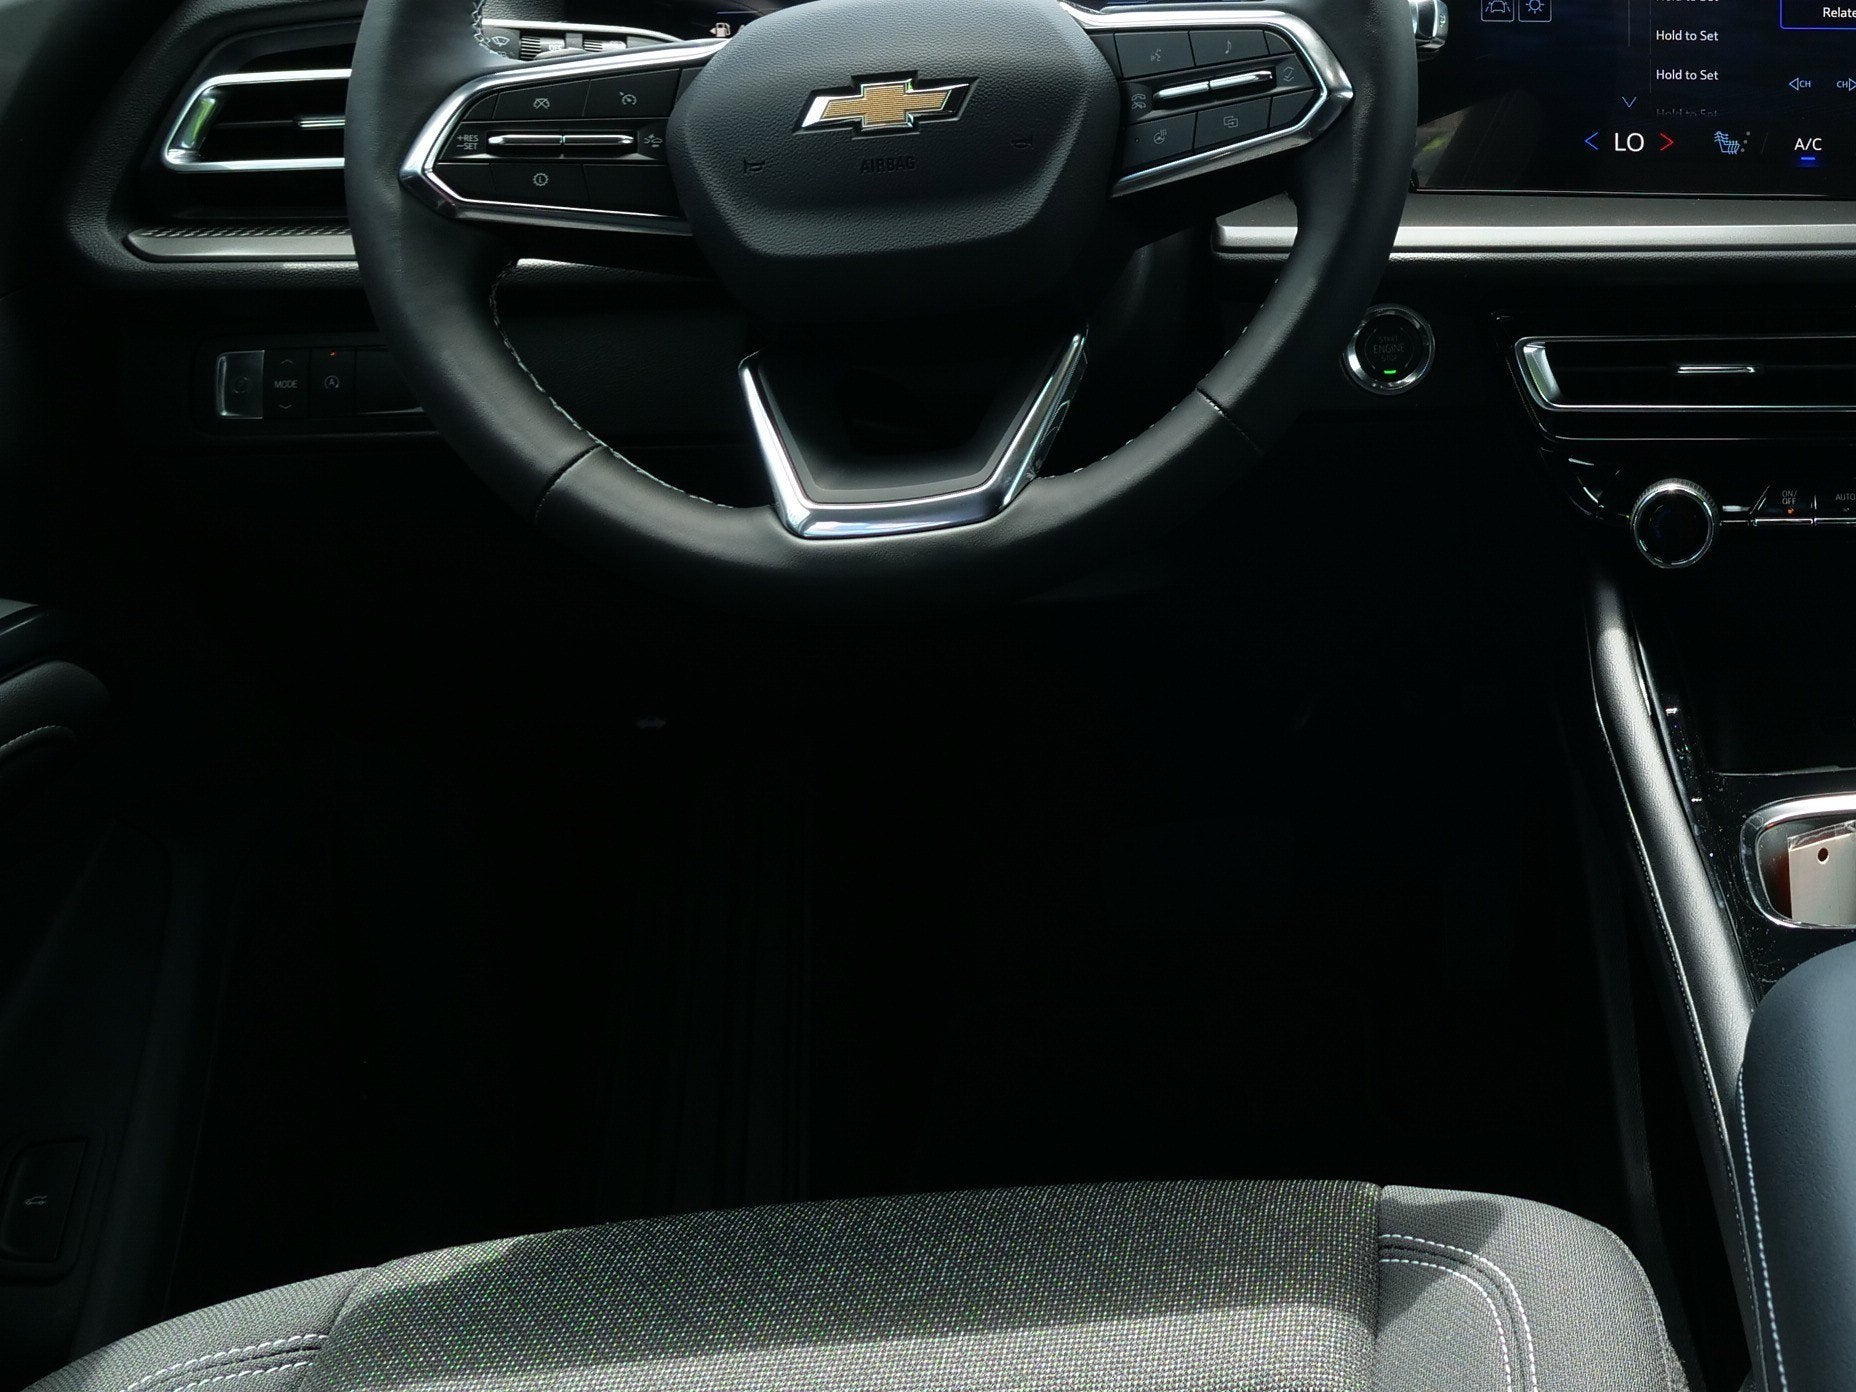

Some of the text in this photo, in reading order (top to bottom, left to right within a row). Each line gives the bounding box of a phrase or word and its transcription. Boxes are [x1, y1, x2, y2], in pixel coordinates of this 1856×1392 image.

[1656, 30, 1719, 41] Hold to Set
[1656, 70, 1719, 81] Hold to Set
[1800, 80, 1811, 88] CH
[1836, 80, 1848, 88] CH
[1614, 132, 1645, 152] LO
[1794, 138, 1822, 151] A/C
[274, 380, 298, 389] MODE
[1782, 490, 1798, 498] ON/
[1836, 493, 1856, 501] AUTO
